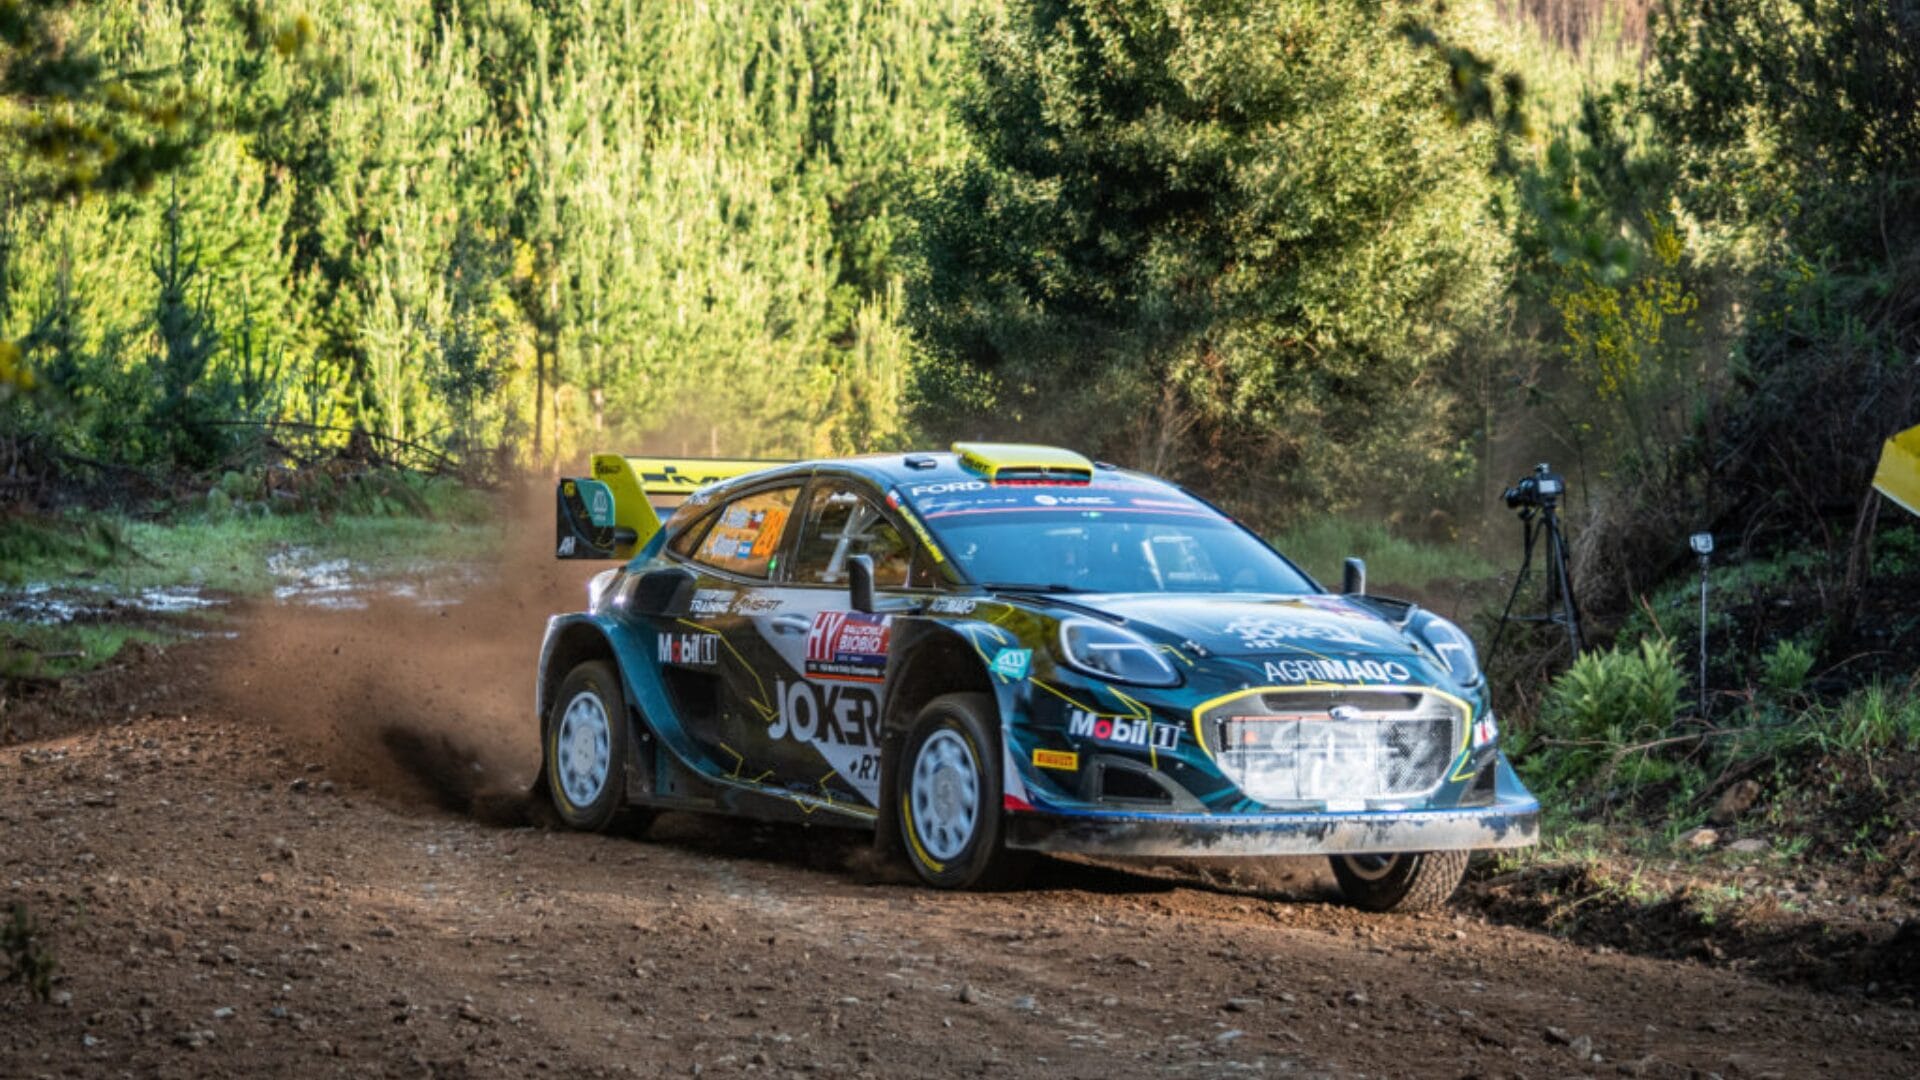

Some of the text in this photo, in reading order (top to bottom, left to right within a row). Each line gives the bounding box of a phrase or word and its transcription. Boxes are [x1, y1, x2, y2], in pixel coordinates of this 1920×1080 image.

[912, 481, 986, 497] FORD
[658, 632, 701, 664] Mobil
[768, 680, 882, 748] JOKER
[1069, 710, 1148, 746] Mobil
